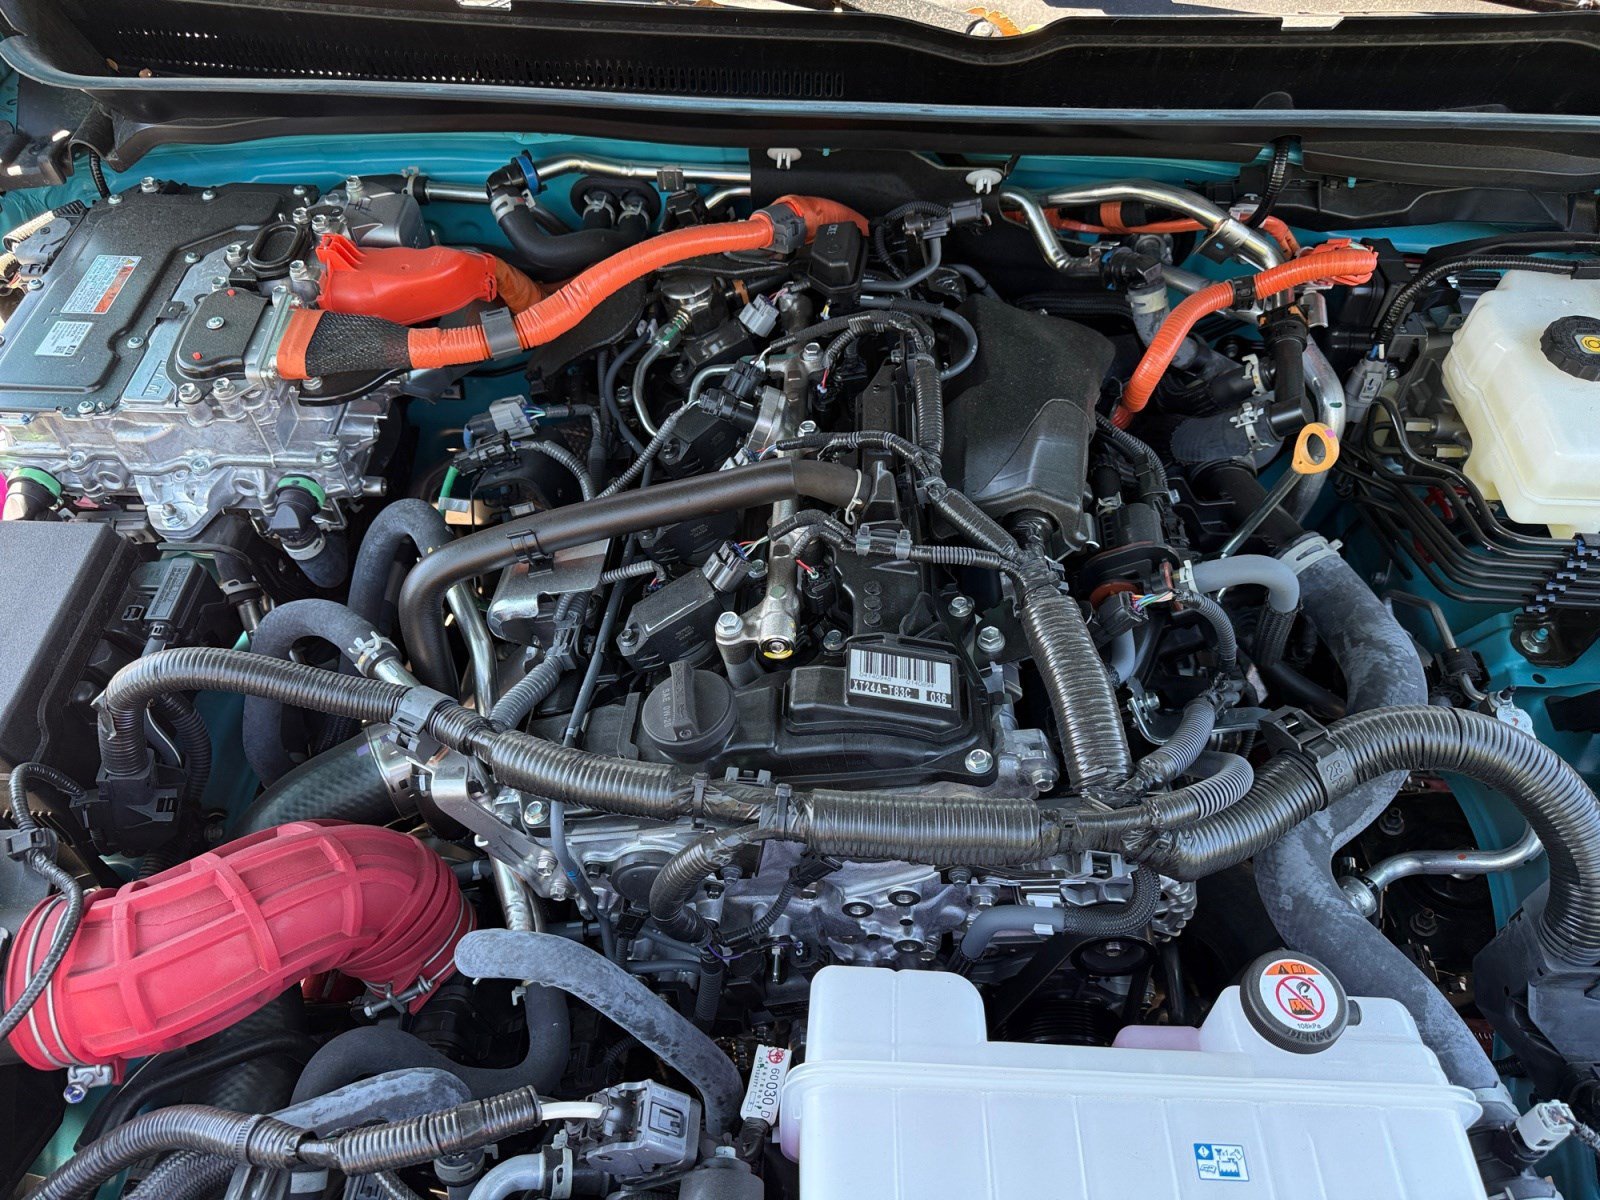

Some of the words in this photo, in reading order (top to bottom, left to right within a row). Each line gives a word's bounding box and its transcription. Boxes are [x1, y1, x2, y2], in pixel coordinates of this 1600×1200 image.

[662, 688, 671, 702] SAE
[852, 679, 912, 698] XT24A-T83C
[930, 692, 948, 705] 036
[1326, 760, 1344, 781] 28
